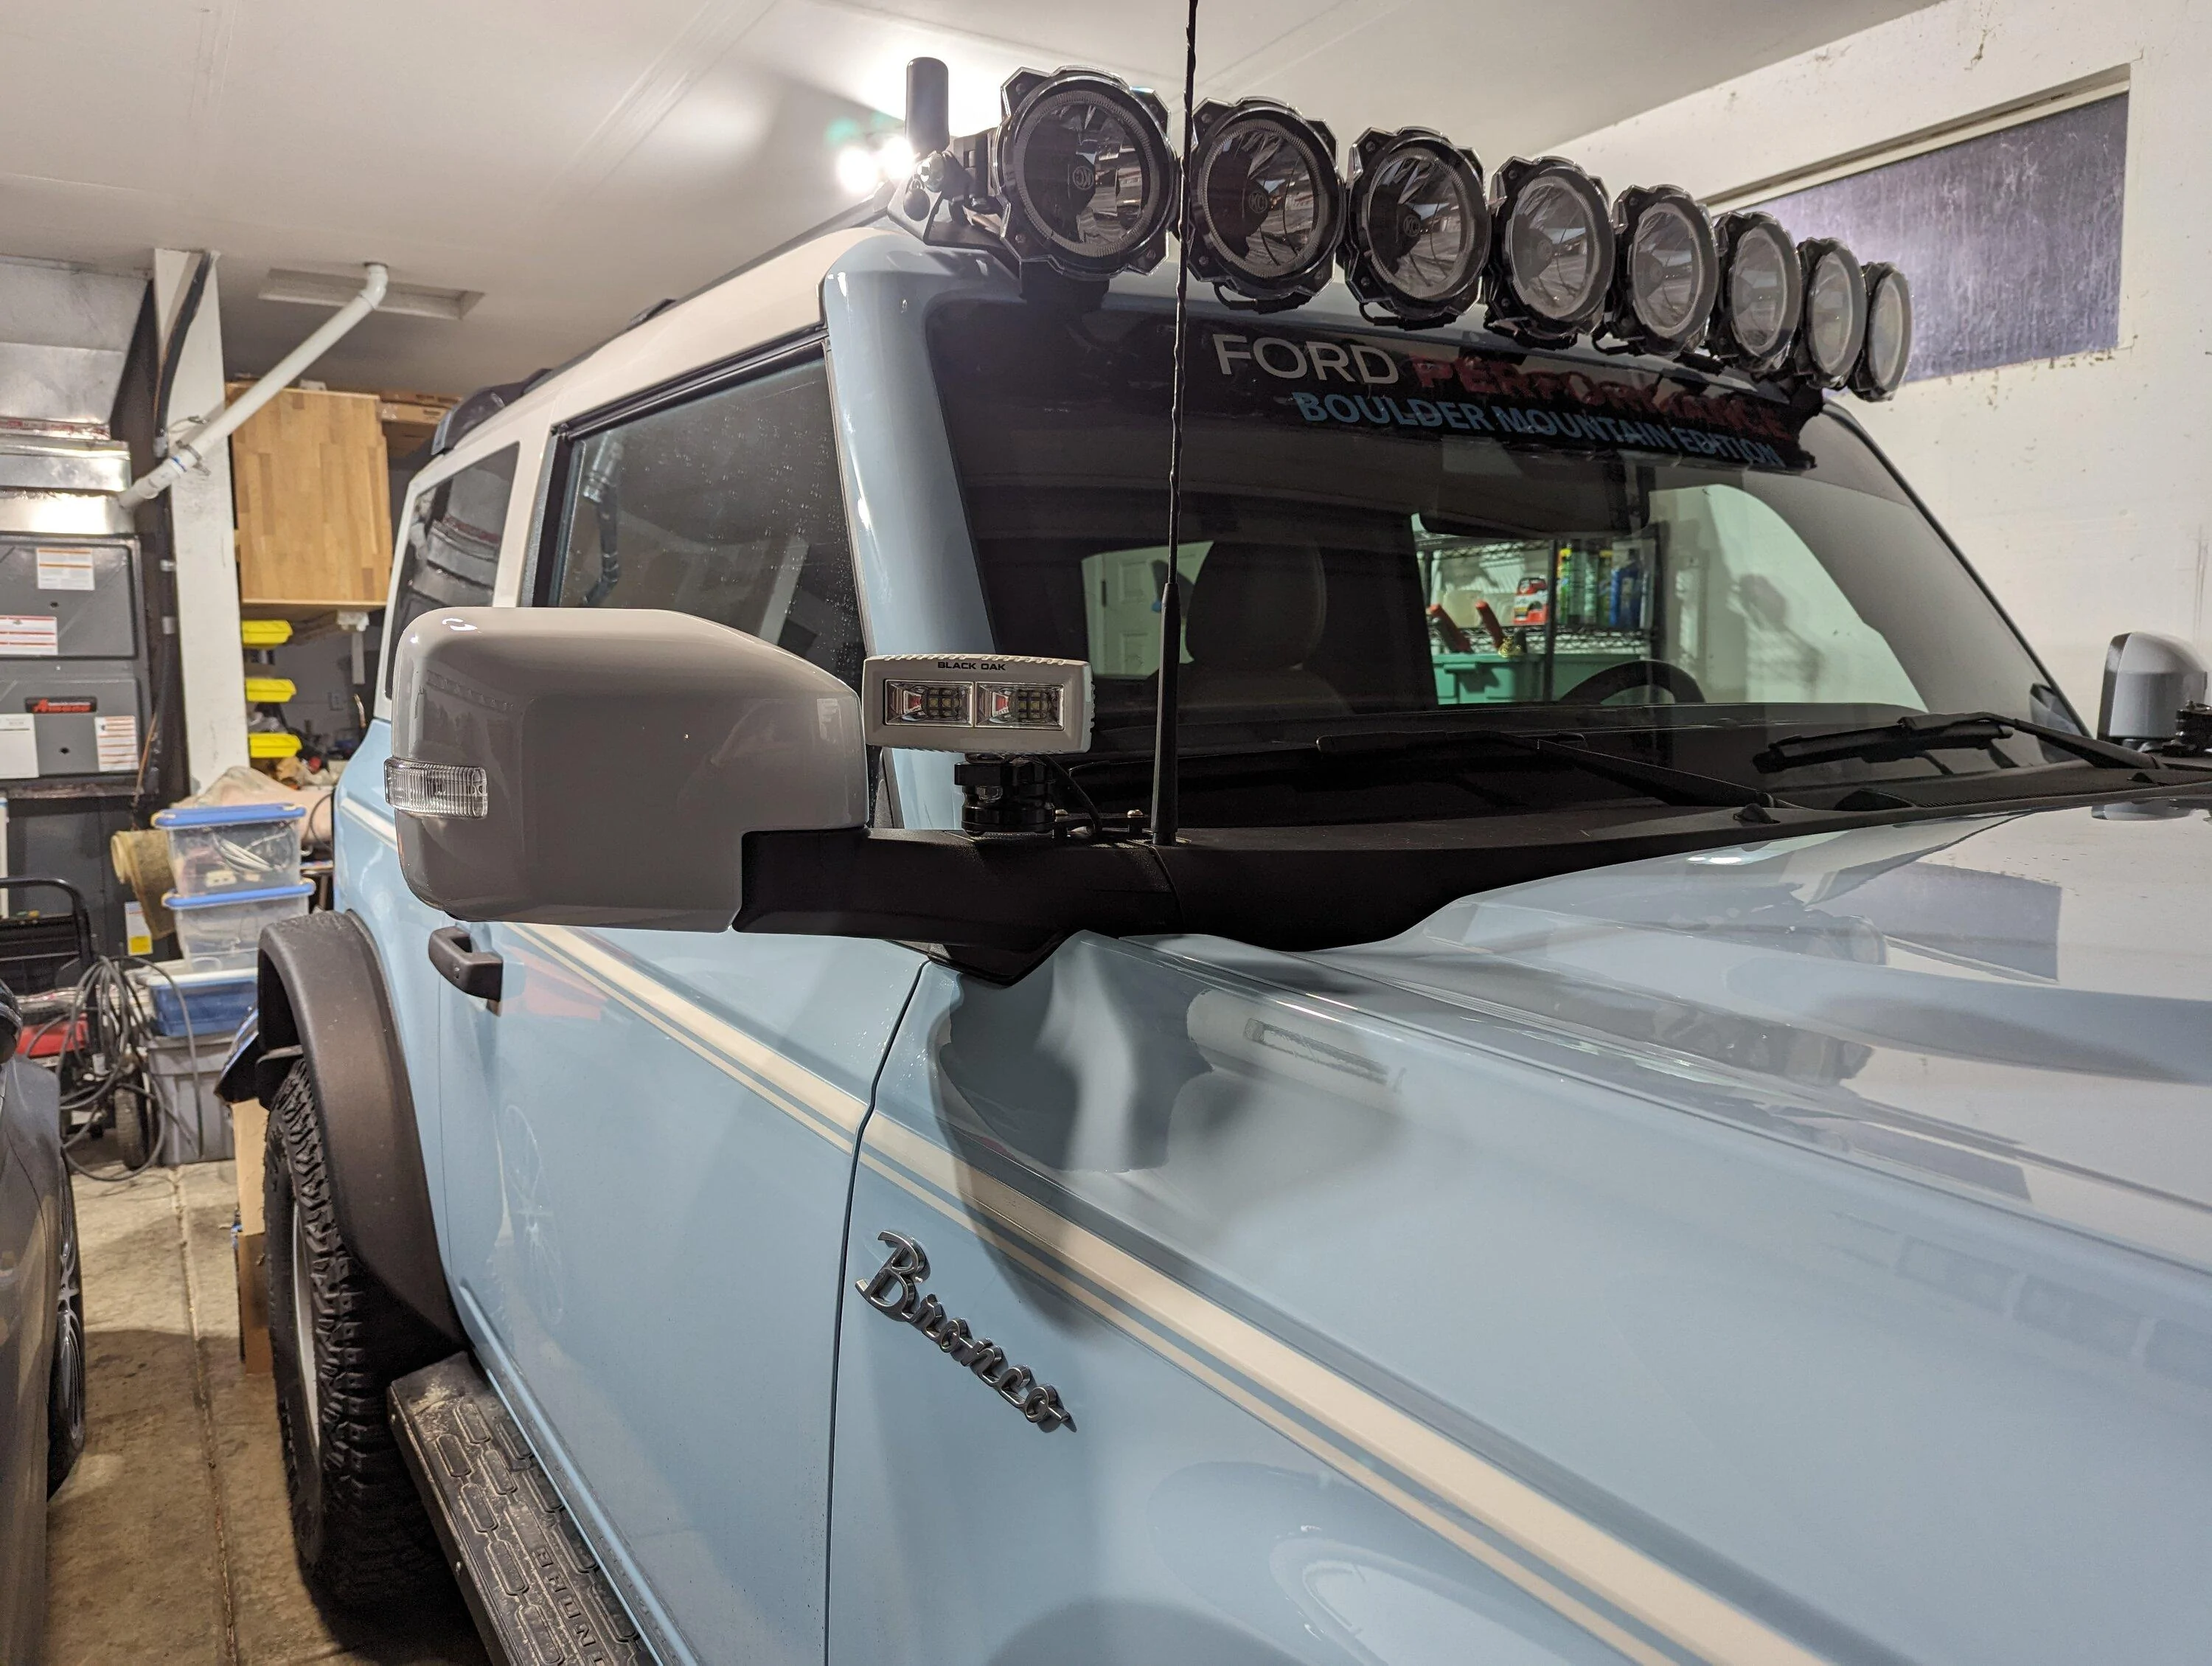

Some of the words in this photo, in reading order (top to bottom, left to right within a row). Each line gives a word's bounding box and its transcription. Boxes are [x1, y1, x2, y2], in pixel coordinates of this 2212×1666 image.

[1212, 333, 1399, 384] FORD
[1292, 392, 1495, 431] BOULDER
[1490, 406, 1678, 448] MOUNTAIN
[1671, 426, 1787, 468] EDITION
[937, 662, 976, 670] BLACK
[855, 1229, 1072, 1425] Bronco
